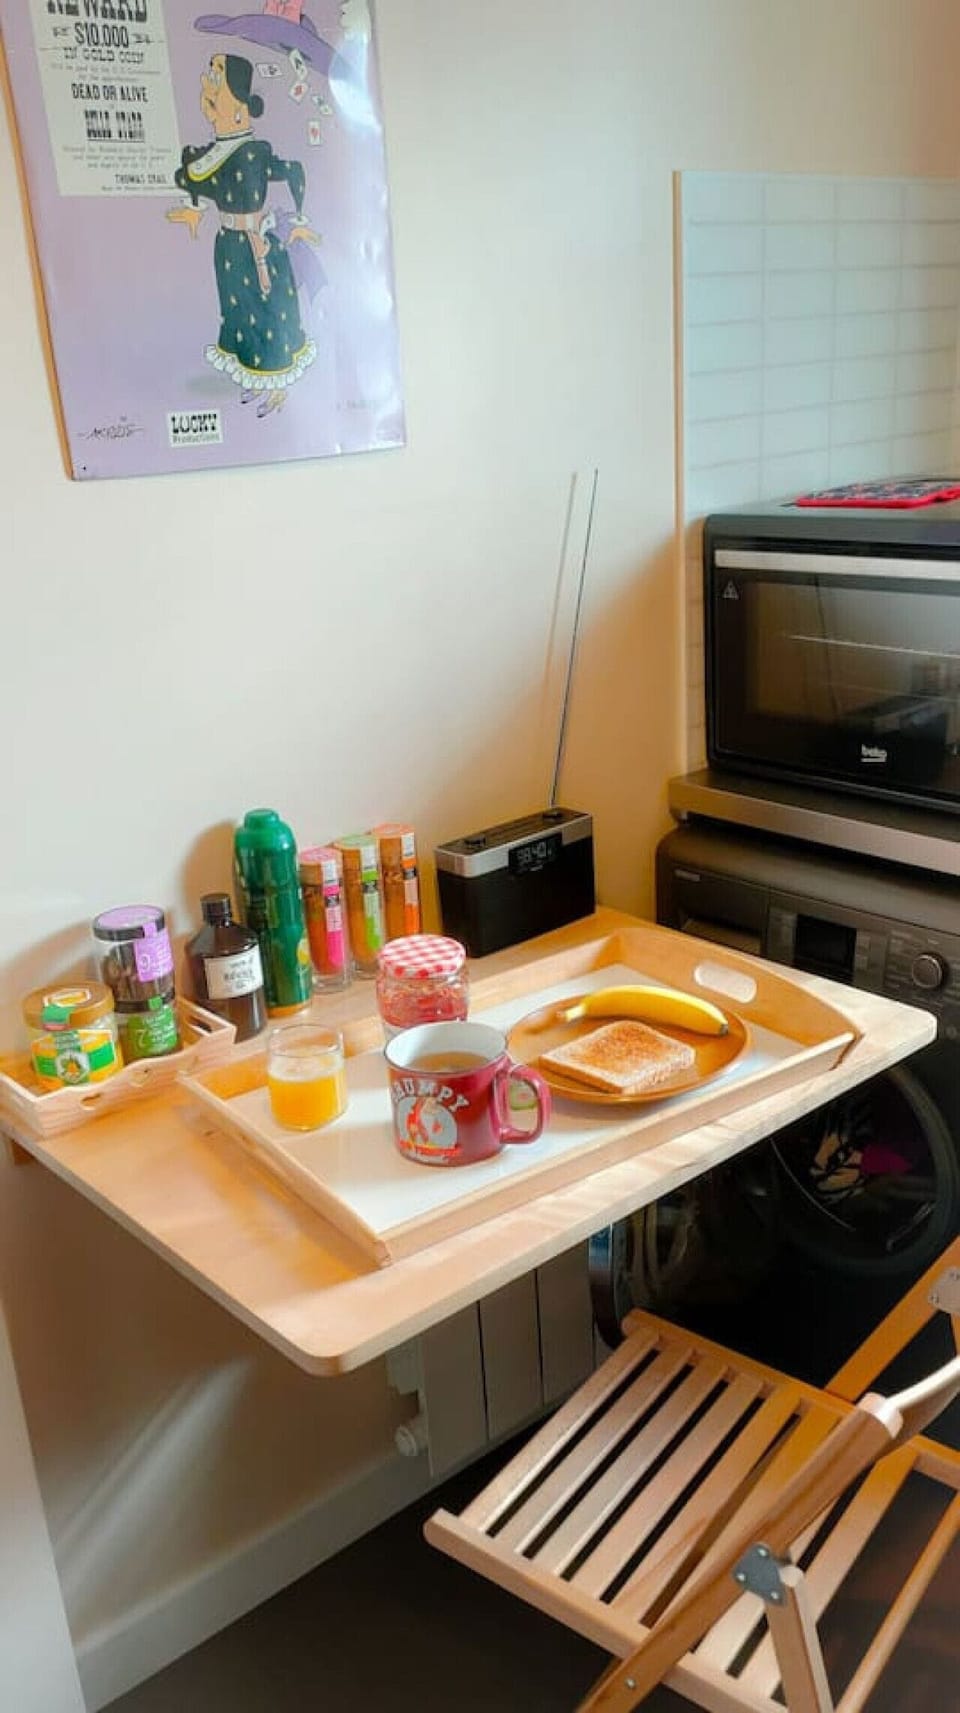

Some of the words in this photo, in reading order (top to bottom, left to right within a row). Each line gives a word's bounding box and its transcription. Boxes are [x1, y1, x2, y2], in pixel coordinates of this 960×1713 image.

[71, 83, 101, 100] DEAD
[102, 85, 117, 101] OR
[119, 86, 149, 103] ALIVE
[171, 413, 217, 434] LUCKY
